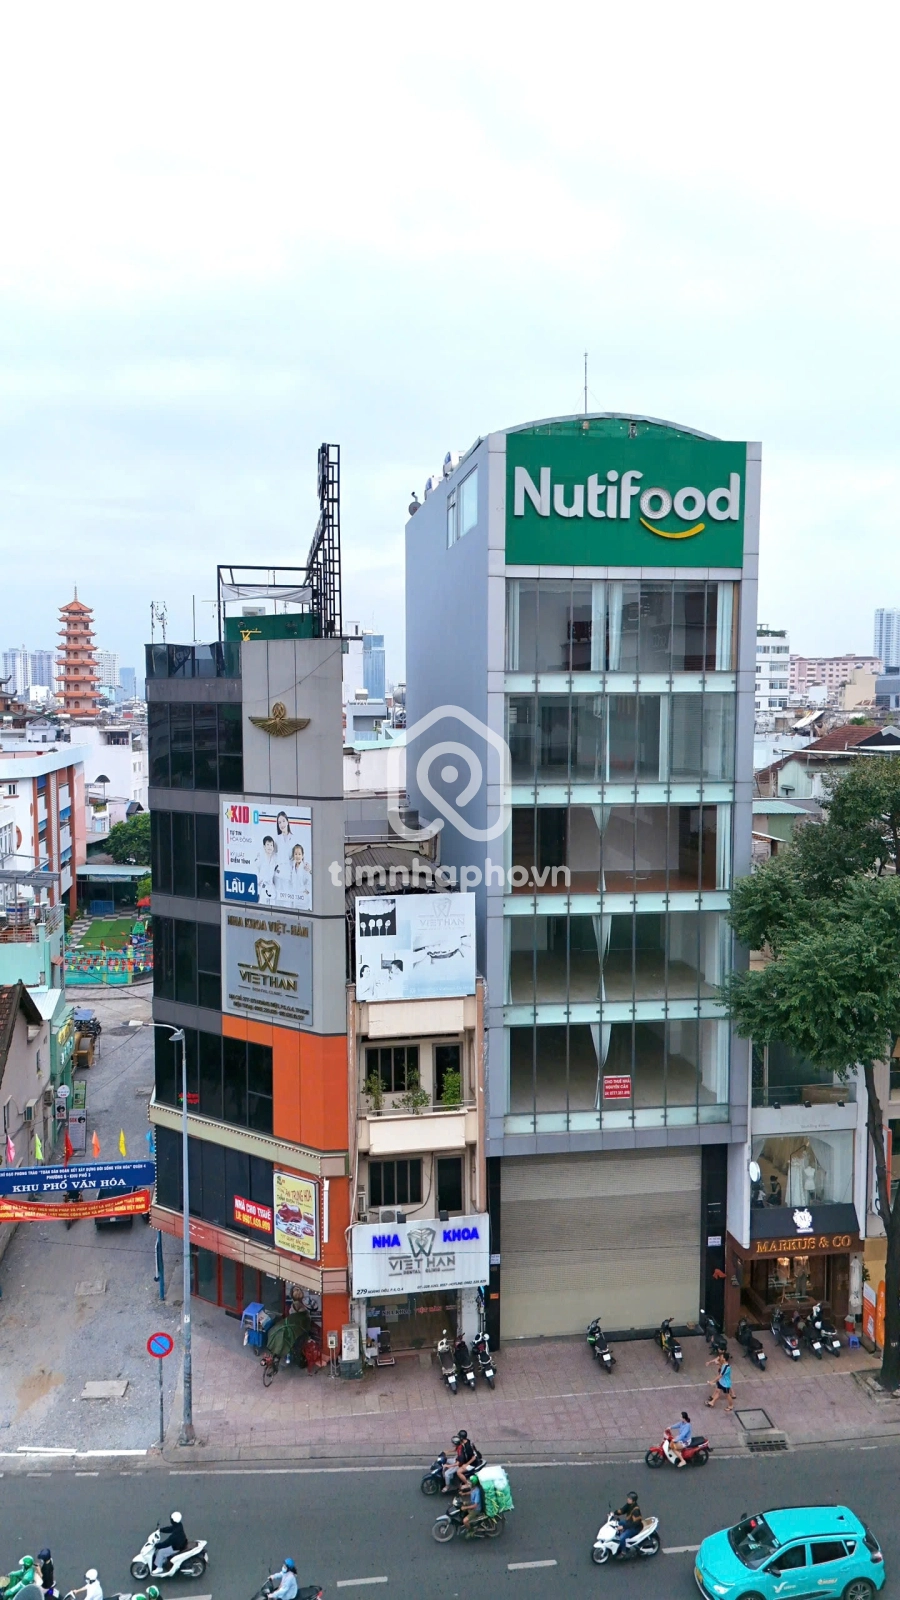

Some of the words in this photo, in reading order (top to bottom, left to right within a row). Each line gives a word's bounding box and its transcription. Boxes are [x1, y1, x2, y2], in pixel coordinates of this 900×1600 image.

[513, 466, 740, 521] Nutifood
[226, 877, 245, 894] LẦU
[248, 883, 256, 895] 4
[12, 1184, 39, 1192] KHU
[43, 1179, 68, 1190] PHỐ
[71, 1180, 96, 1189] VĂN
[100, 1177, 126, 1187] HÓA
[235, 1198, 245, 1211] NHÀ
[246, 1203, 256, 1215] CHO
[257, 1208, 271, 1220] THUÊ
[372, 1234, 400, 1249] NHA
[443, 1227, 479, 1242] KHOA
[756, 1238, 816, 1253] MARKUS
[818, 1236, 829, 1248] &
[832, 1235, 851, 1247] CO
[388, 1258, 423, 1271] VIET
[426, 1255, 455, 1268] HAN
